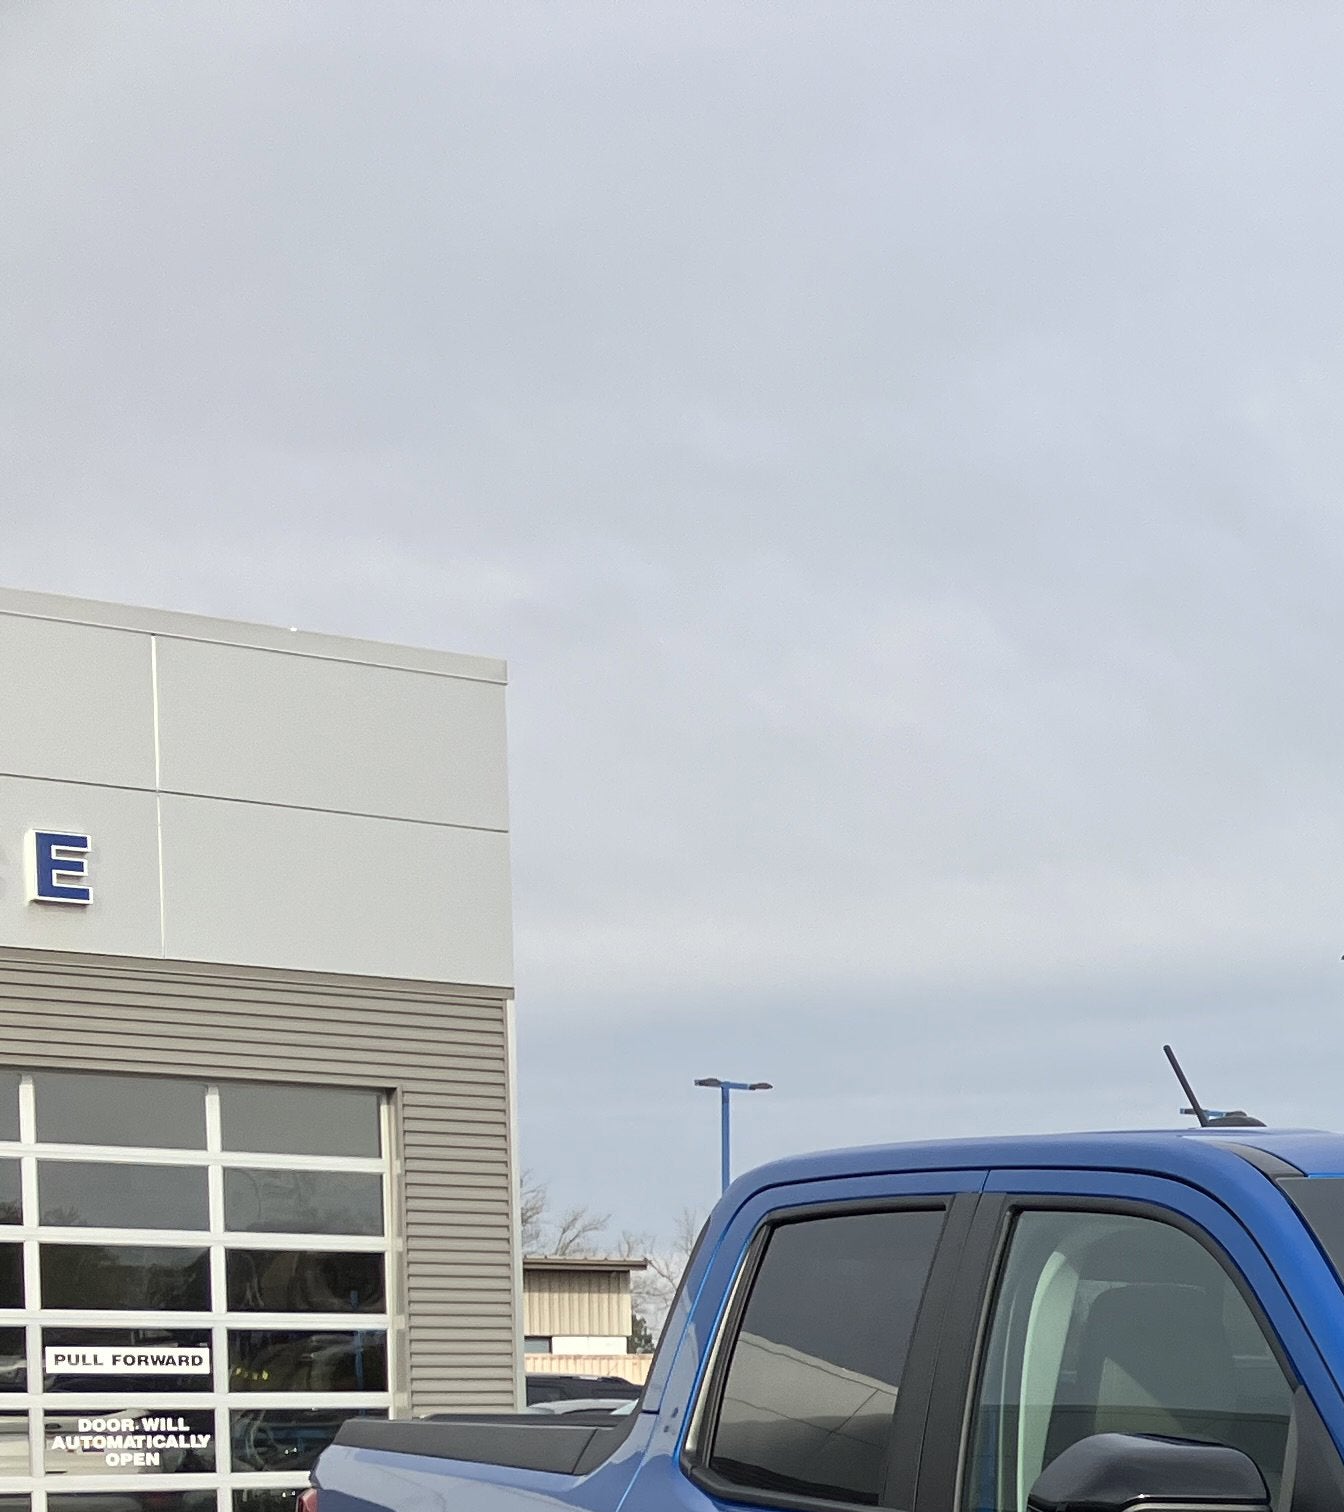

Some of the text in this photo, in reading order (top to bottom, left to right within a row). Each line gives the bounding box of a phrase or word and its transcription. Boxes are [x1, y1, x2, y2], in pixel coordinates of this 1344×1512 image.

[29, 828, 94, 904] E
[53, 1353, 204, 1367] PULL FORWARD
[77, 1416, 191, 1433] DOOR WILL
[51, 1433, 212, 1451] AUTOMATICALLY
[104, 1451, 161, 1467] OPEN
